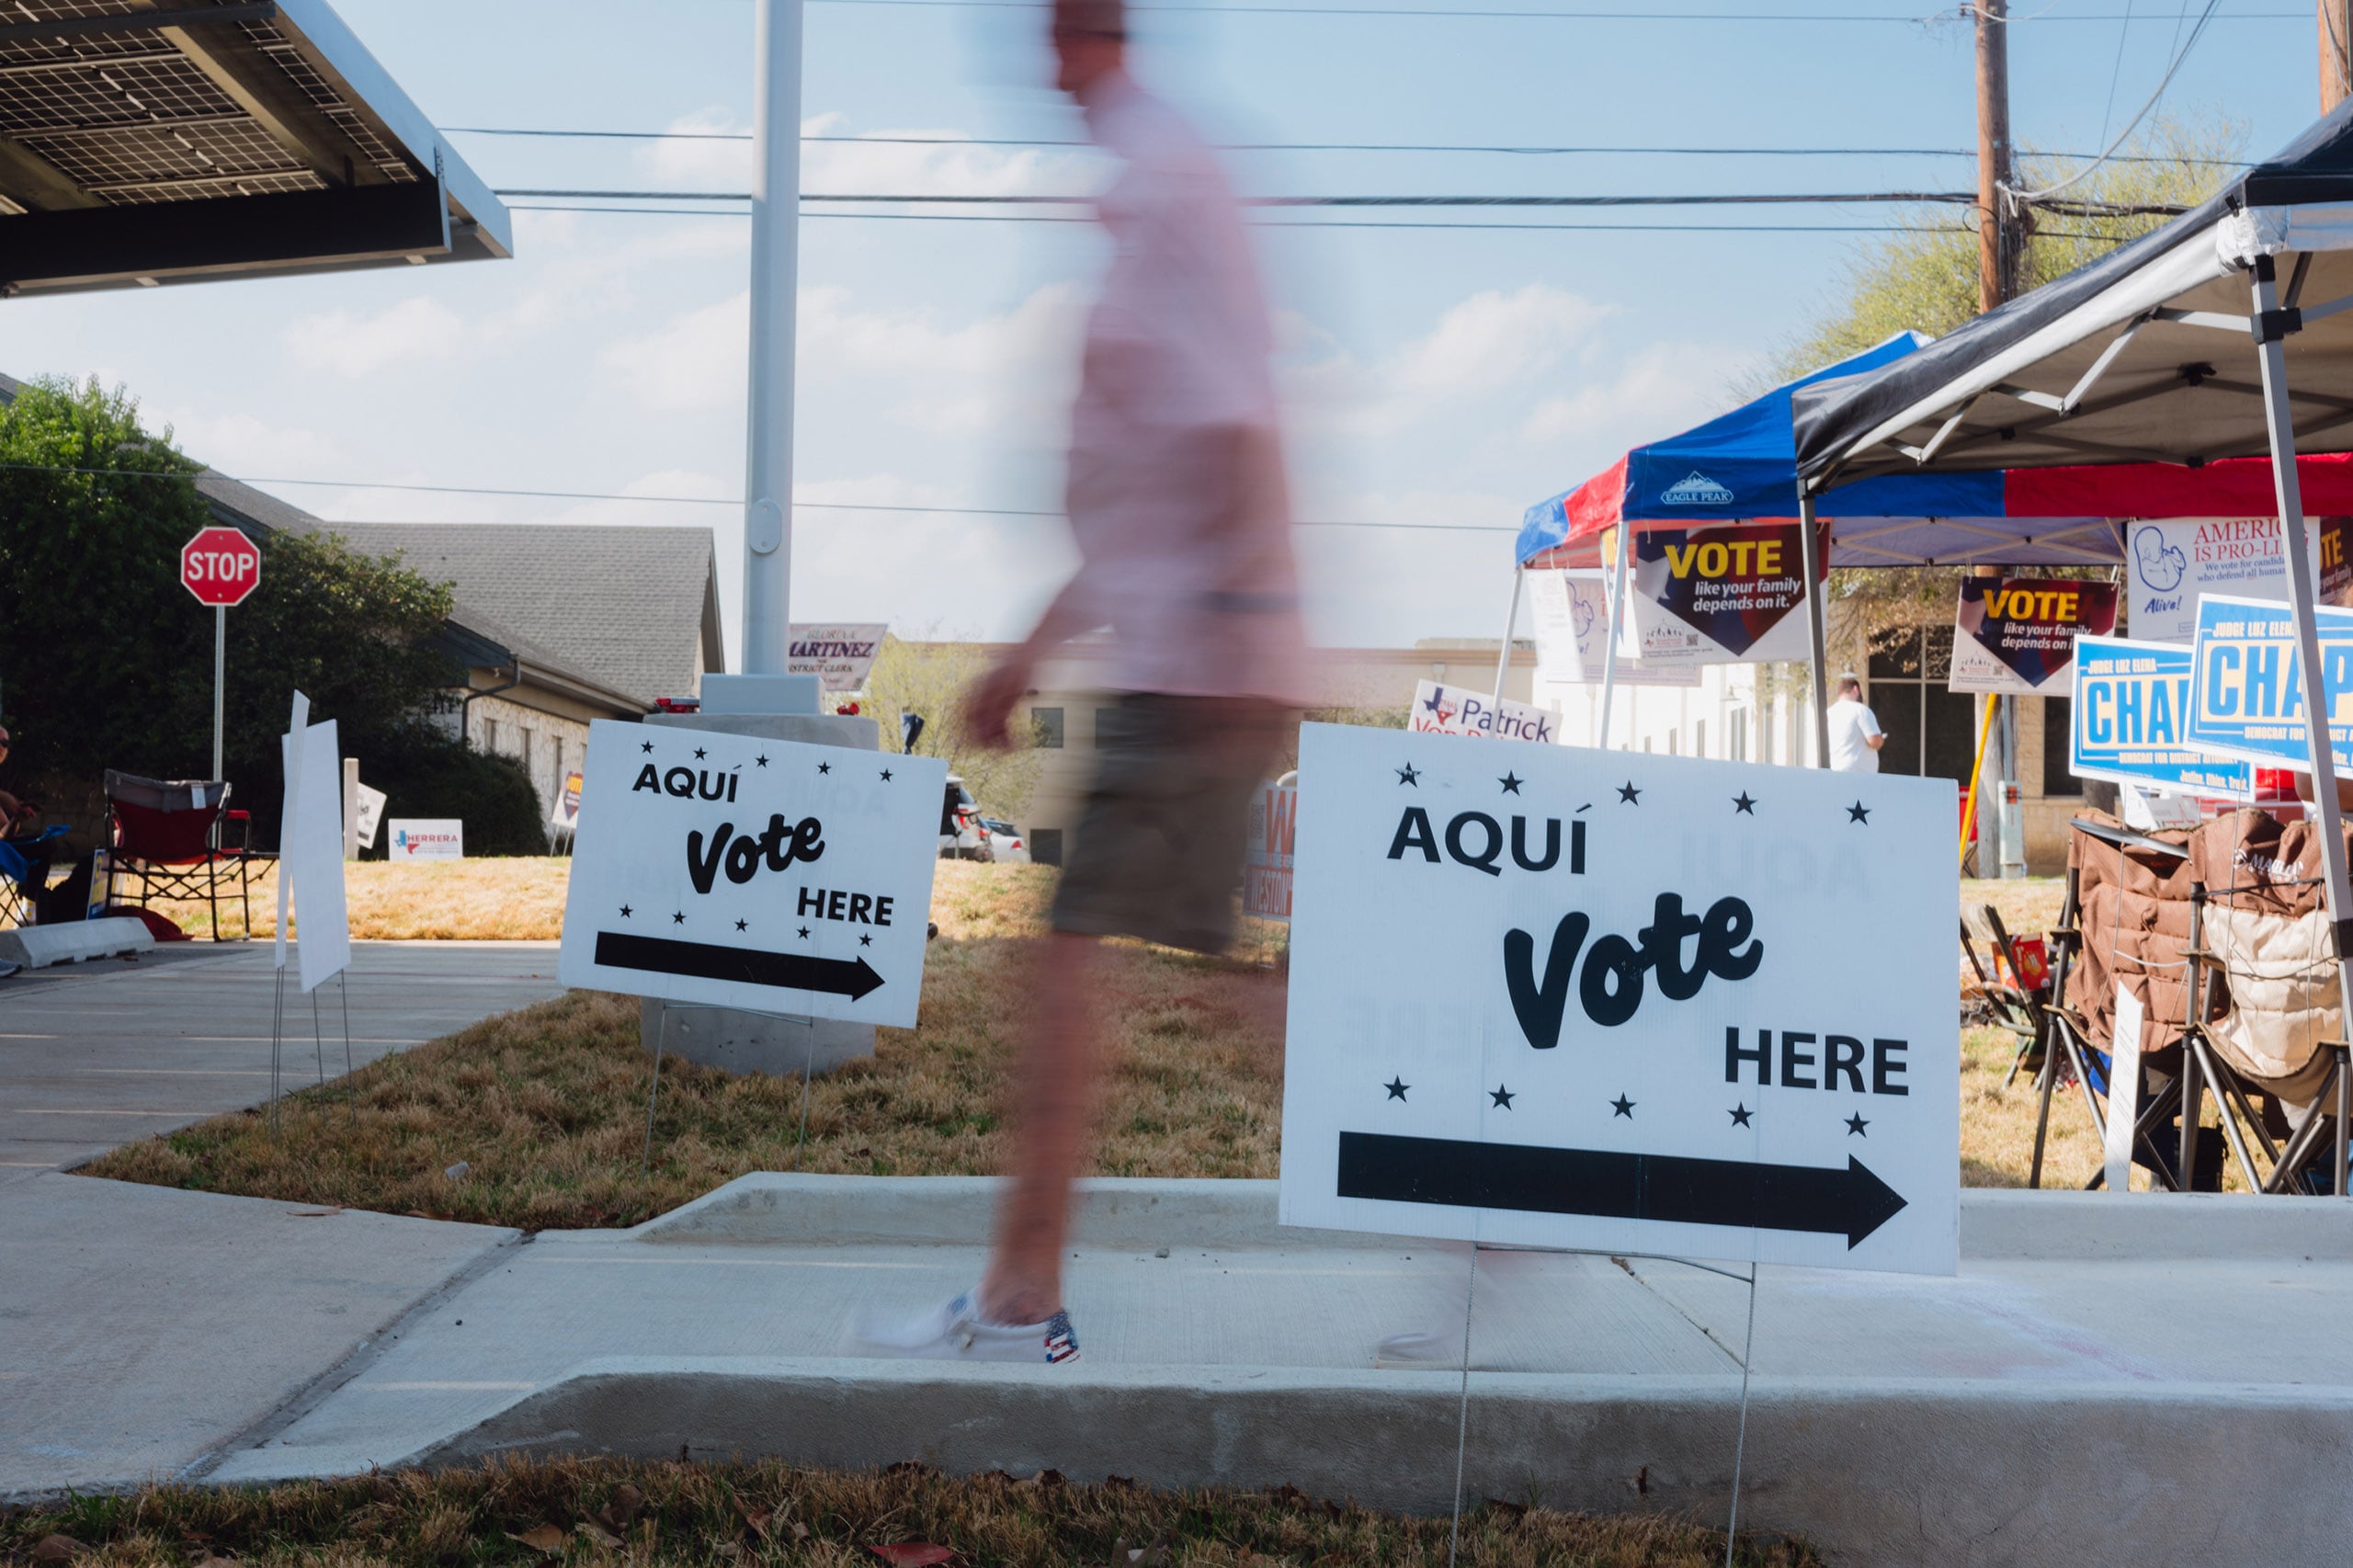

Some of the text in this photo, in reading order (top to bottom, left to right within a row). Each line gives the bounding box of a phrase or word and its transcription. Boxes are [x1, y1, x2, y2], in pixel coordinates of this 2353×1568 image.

[1665, 491, 1729, 502] EAGLE PEAK
[2194, 517, 2308, 545] AMERI
[2195, 546, 2212, 562] IS
[2319, 528, 2344, 569] TE
[187, 551, 255, 582] STOP
[1664, 540, 1782, 579] VOTE
[2205, 554, 2285, 572] We vote for candida
[2197, 574, 2216, 582] who
[2216, 570, 2245, 581] defend
[2246, 568, 2257, 578] all
[1695, 576, 1802, 598] like your family
[1692, 594, 1790, 615] depends on it.
[1983, 588, 2079, 622] VOTE
[2144, 596, 2183, 614] Alive!
[2004, 621, 2092, 638] like your family
[2212, 621, 2245, 638] JUDGE
[2247, 621, 2267, 638] LUZ
[2268, 620, 2295, 637] ELEN
[2001, 636, 2052, 652] depends
[2052, 639, 2068, 651] on
[2087, 657, 2157, 675] JUDGE LUZ ELENA
[1461, 698, 1552, 744] Patrick
[2244, 725, 2288, 741] DEMOCRAT
[2289, 727, 2306, 741] FOR
[2118, 752, 2154, 765] DEMOCRAT
[2169, 752, 2201, 765] DISTRICT
[631, 763, 743, 803] AQUÍ
[406, 834, 459, 843] HERRERA
[1387, 802, 1593, 877] AQUÍ
[687, 813, 825, 894] Vote
[796, 886, 894, 926] HERE
[1504, 892, 1765, 1050] Vote
[1724, 1026, 1909, 1096] HERE
